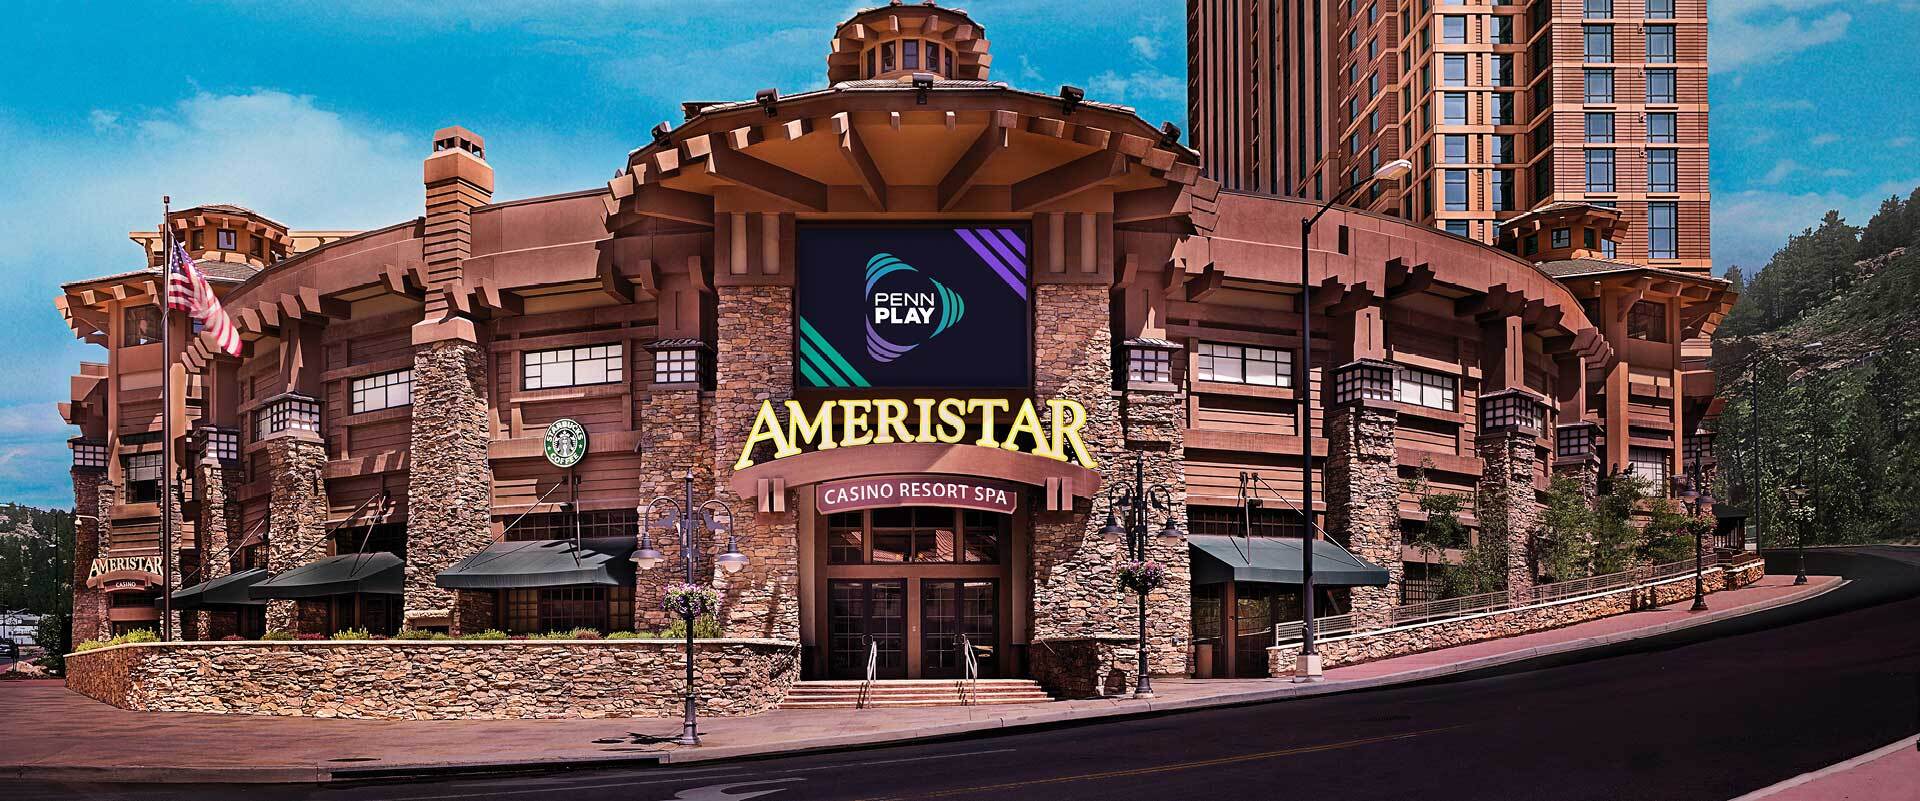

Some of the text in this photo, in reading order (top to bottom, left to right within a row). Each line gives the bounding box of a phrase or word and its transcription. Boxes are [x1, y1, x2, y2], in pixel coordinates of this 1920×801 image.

[875, 292, 934, 306] PENN
[875, 307, 935, 324] PLAY
[547, 420, 584, 442] STARBUCKS
[734, 397, 1099, 470] AMERISTAR
[550, 453, 579, 465] COFFEE
[824, 482, 1007, 505] CASINO RESORT SPA
[88, 556, 164, 580] AMERISTAR
[115, 580, 136, 588] CASINO
